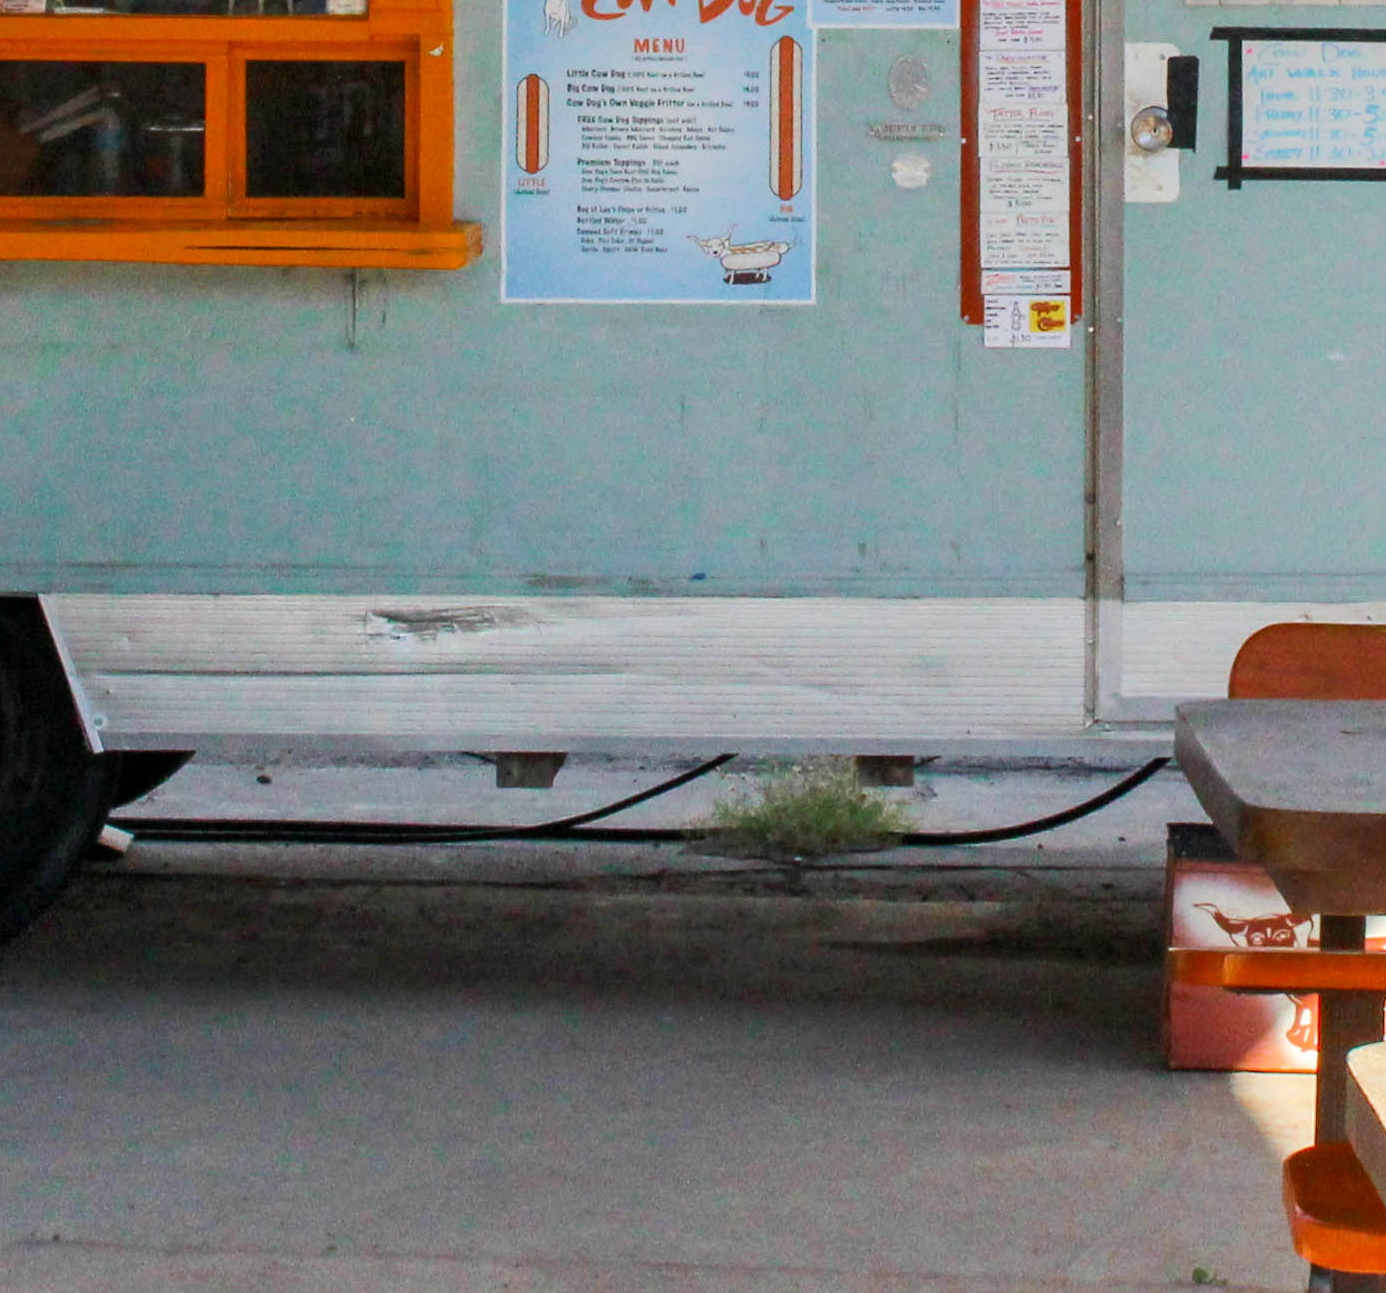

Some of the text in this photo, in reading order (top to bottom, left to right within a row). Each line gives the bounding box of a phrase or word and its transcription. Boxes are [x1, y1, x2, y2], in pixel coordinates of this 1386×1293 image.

[634, 38, 685, 53] MENU
[591, 70, 608, 78] Cow
[610, 70, 626, 79] Dog
[567, 84, 580, 93] Big
[582, 84, 598, 92] Cow
[601, 84, 615, 94] Dog
[567, 99, 583, 107] Cow
[609, 99, 627, 107] Own
